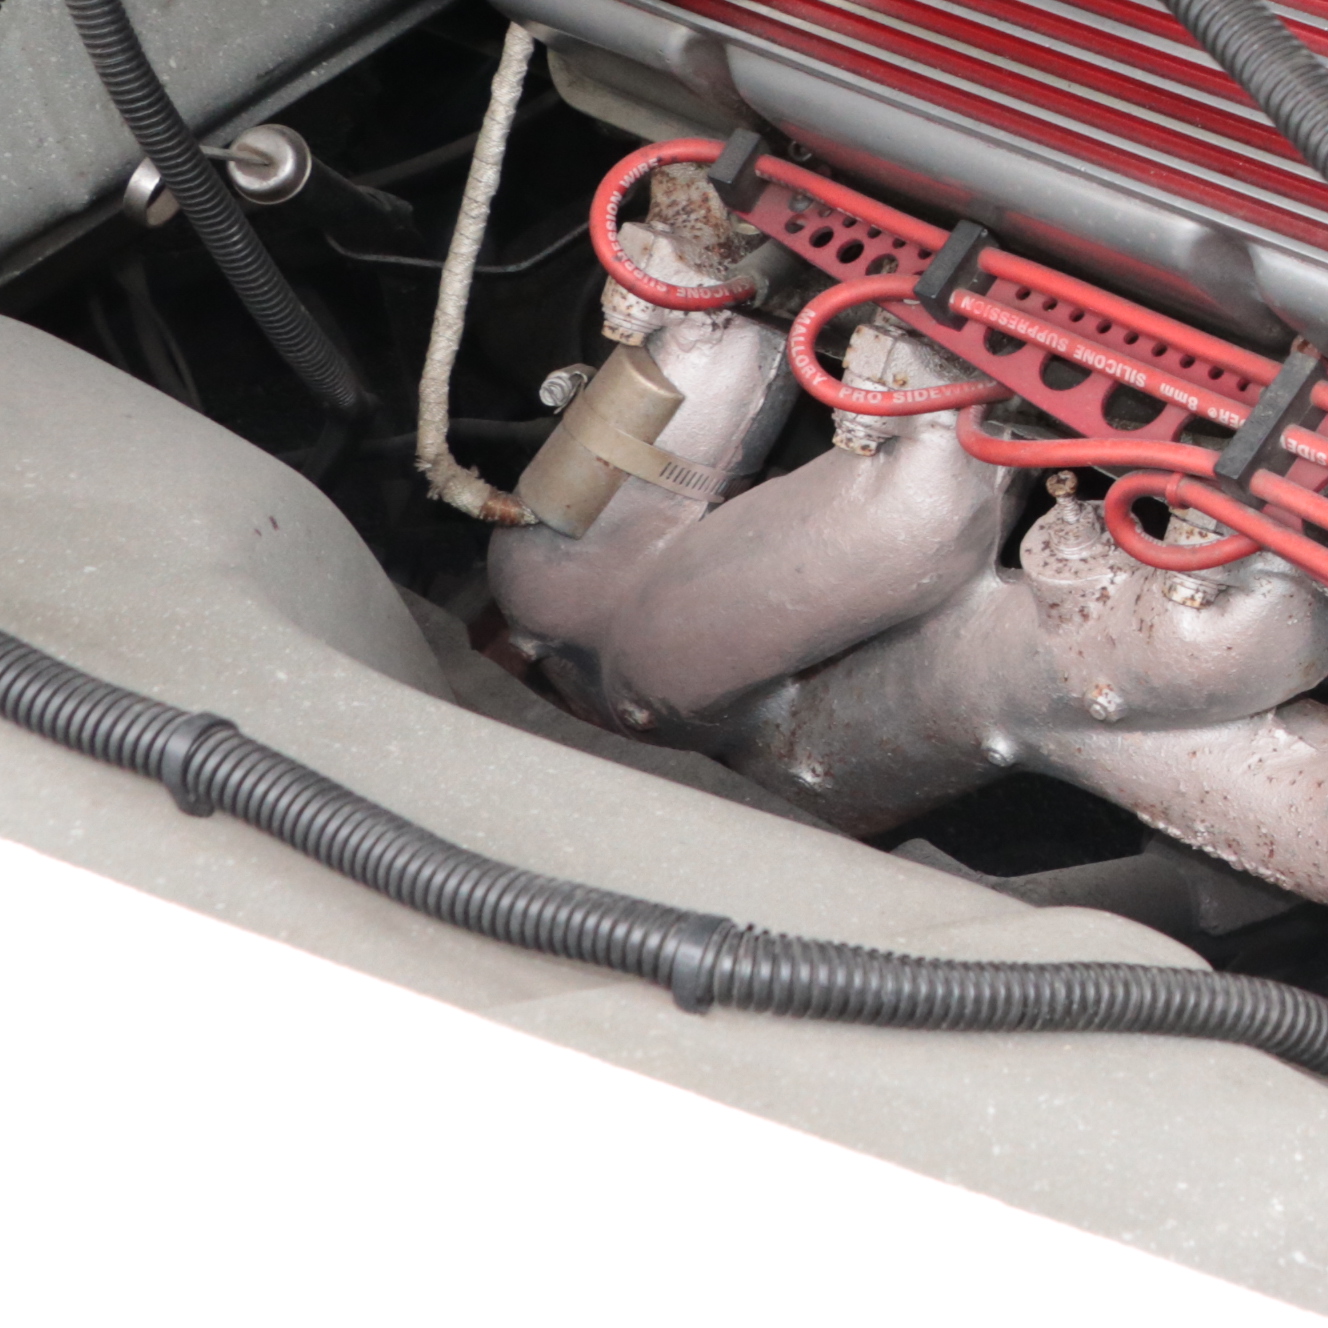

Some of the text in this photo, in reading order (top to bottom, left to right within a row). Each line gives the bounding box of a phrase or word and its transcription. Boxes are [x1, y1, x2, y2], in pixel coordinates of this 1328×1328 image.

[619, 157, 661, 188] WIRE
[961, 292, 1070, 353] SUPPRESSION
[790, 307, 828, 386] MALLORY
[839, 386, 883, 405] PRO
[1073, 343, 1147, 388] SILICONE
[1160, 382, 1199, 411] 8mm
